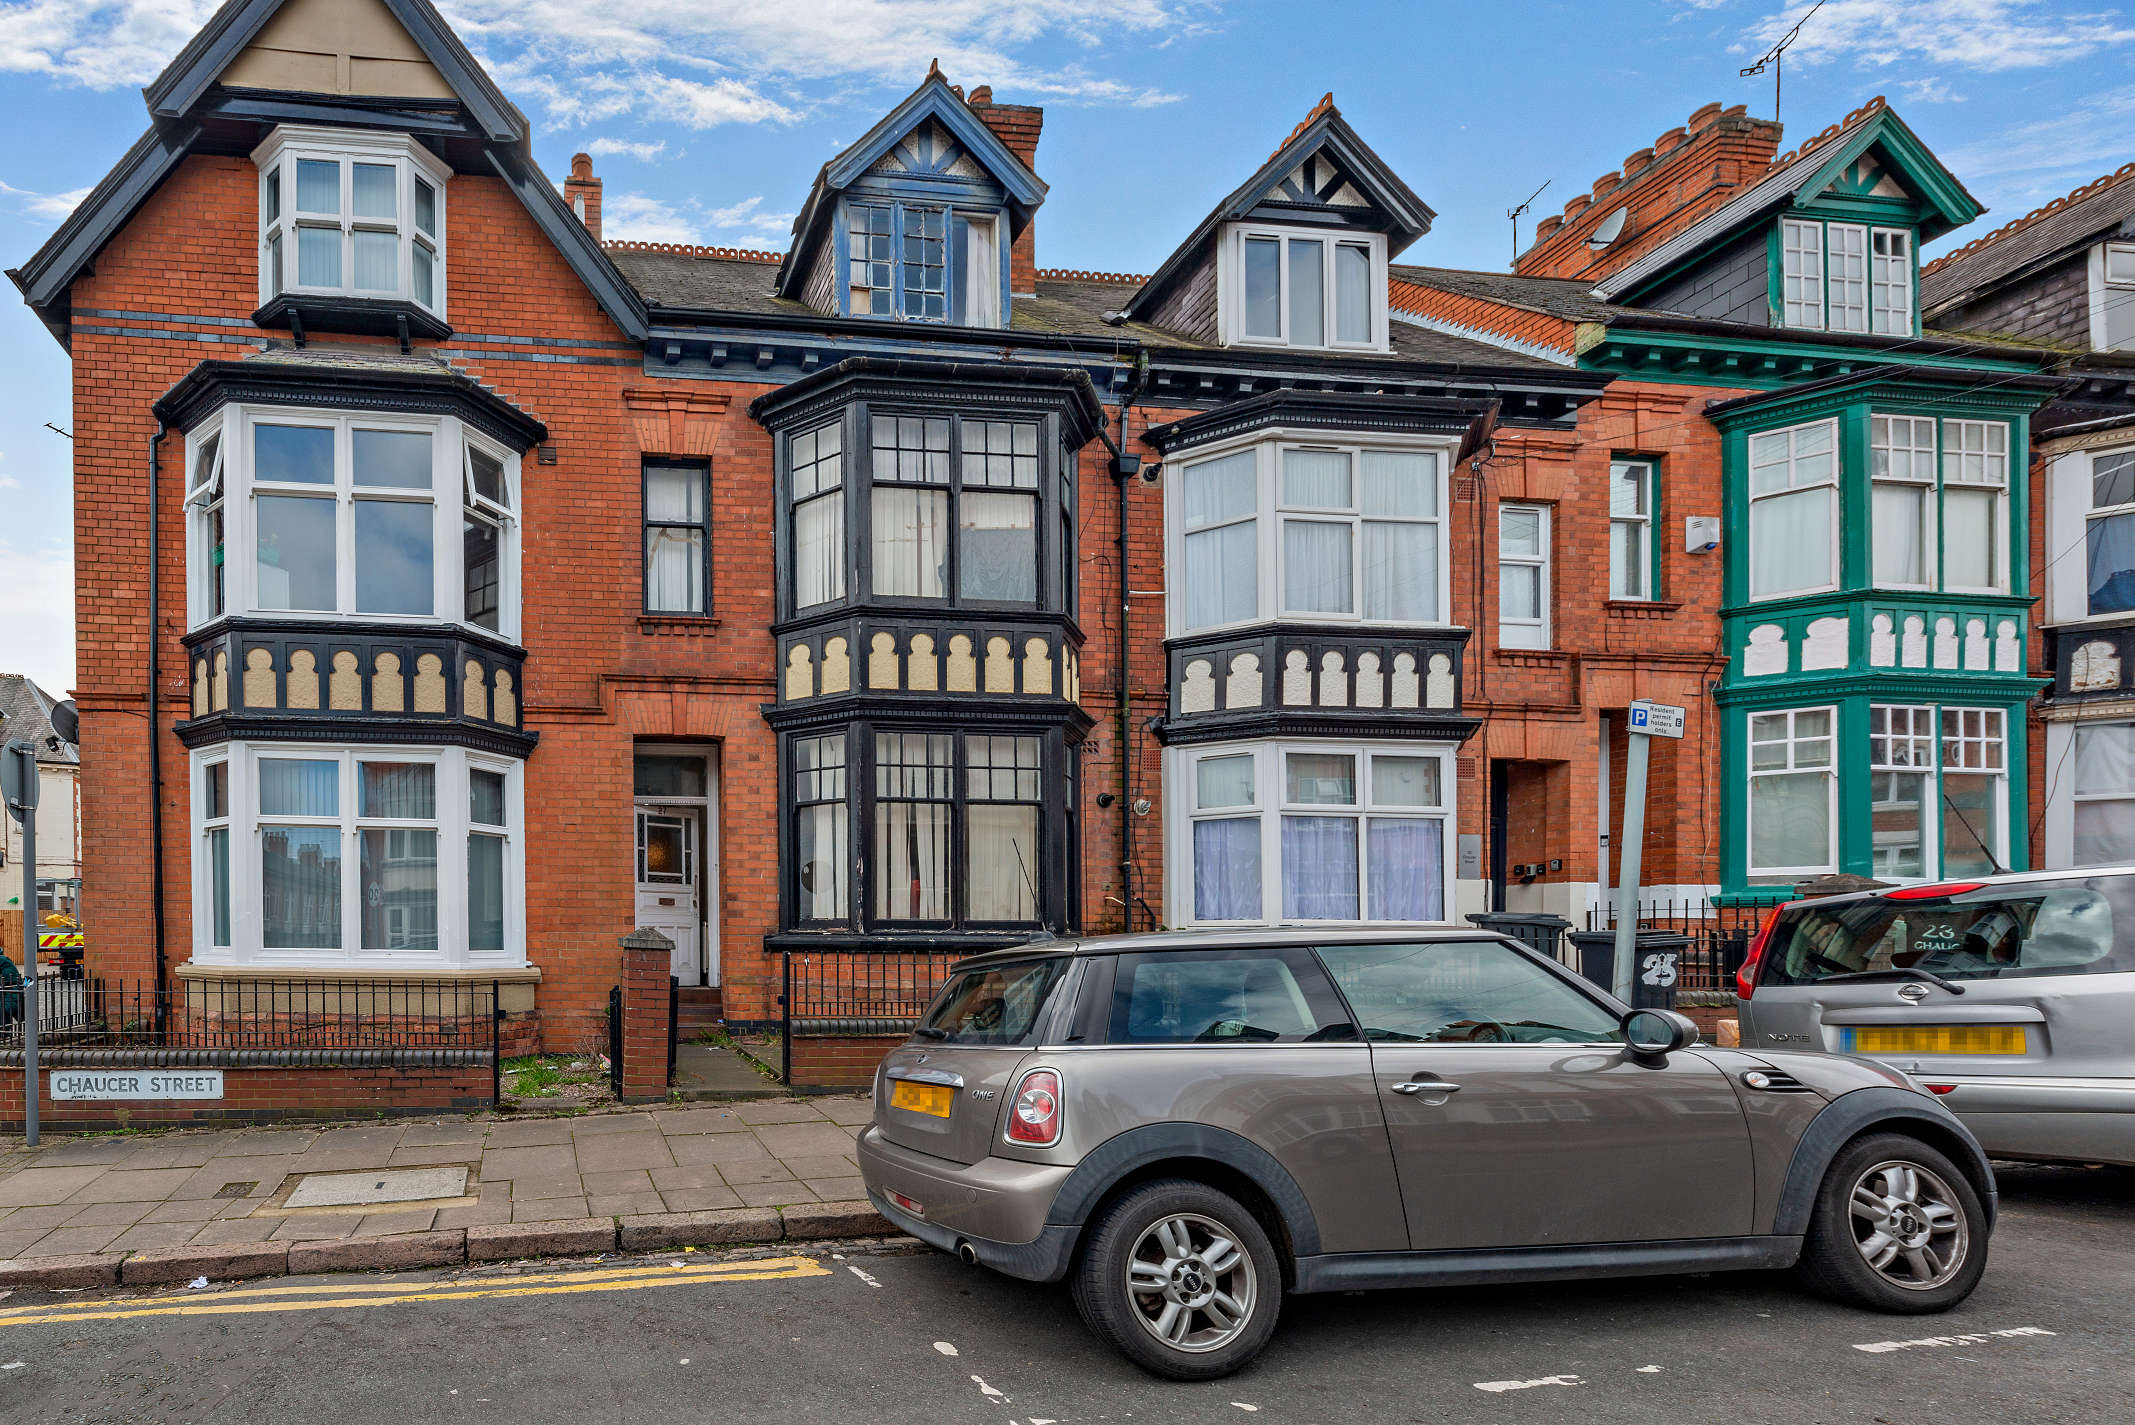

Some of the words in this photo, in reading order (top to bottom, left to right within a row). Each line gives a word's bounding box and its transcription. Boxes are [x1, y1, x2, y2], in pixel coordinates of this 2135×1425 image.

[1650, 720, 1672, 728] holders
[1922, 924, 1955, 939] 23
[1767, 1032, 1810, 1041] NOTE
[57, 1077, 139, 1093] CHAUCER
[150, 1076, 216, 1092] STREET
[972, 1089, 994, 1101] ONE
